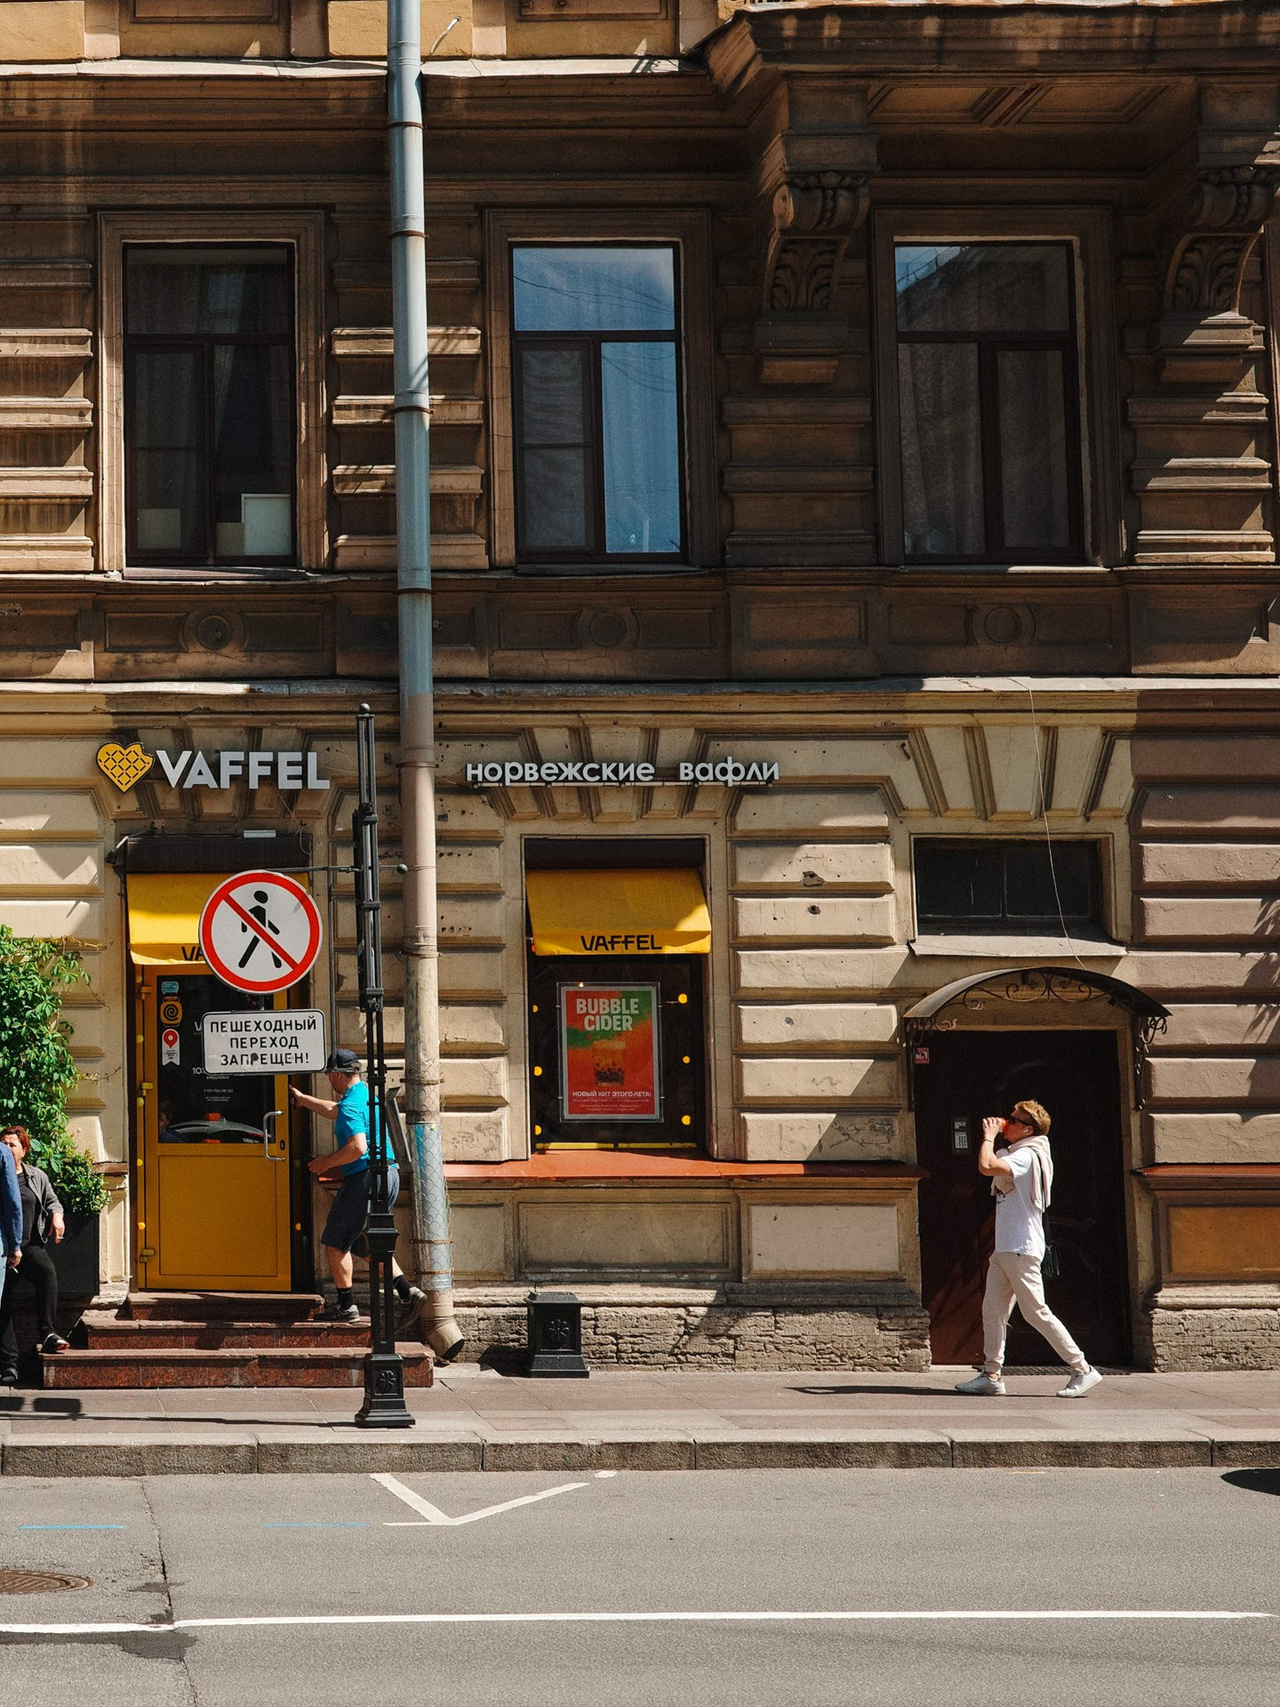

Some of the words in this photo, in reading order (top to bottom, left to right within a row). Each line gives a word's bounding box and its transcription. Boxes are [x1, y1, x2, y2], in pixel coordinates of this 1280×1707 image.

[156, 750, 331, 790] VAFFEL
[466, 761, 656, 787] норвежские
[679, 756, 780, 787] вафли
[580, 934, 663, 951] VAFFEL
[576, 998, 639, 1014] BUBBLE
[210, 1015, 317, 1033] ПЕШЕХОДНЫЙ
[584, 1015, 633, 1031] CIDER
[230, 1036, 300, 1049] ПЕРЕХОД
[220, 1052, 309, 1067] ЗАПРЕЩЕН!
